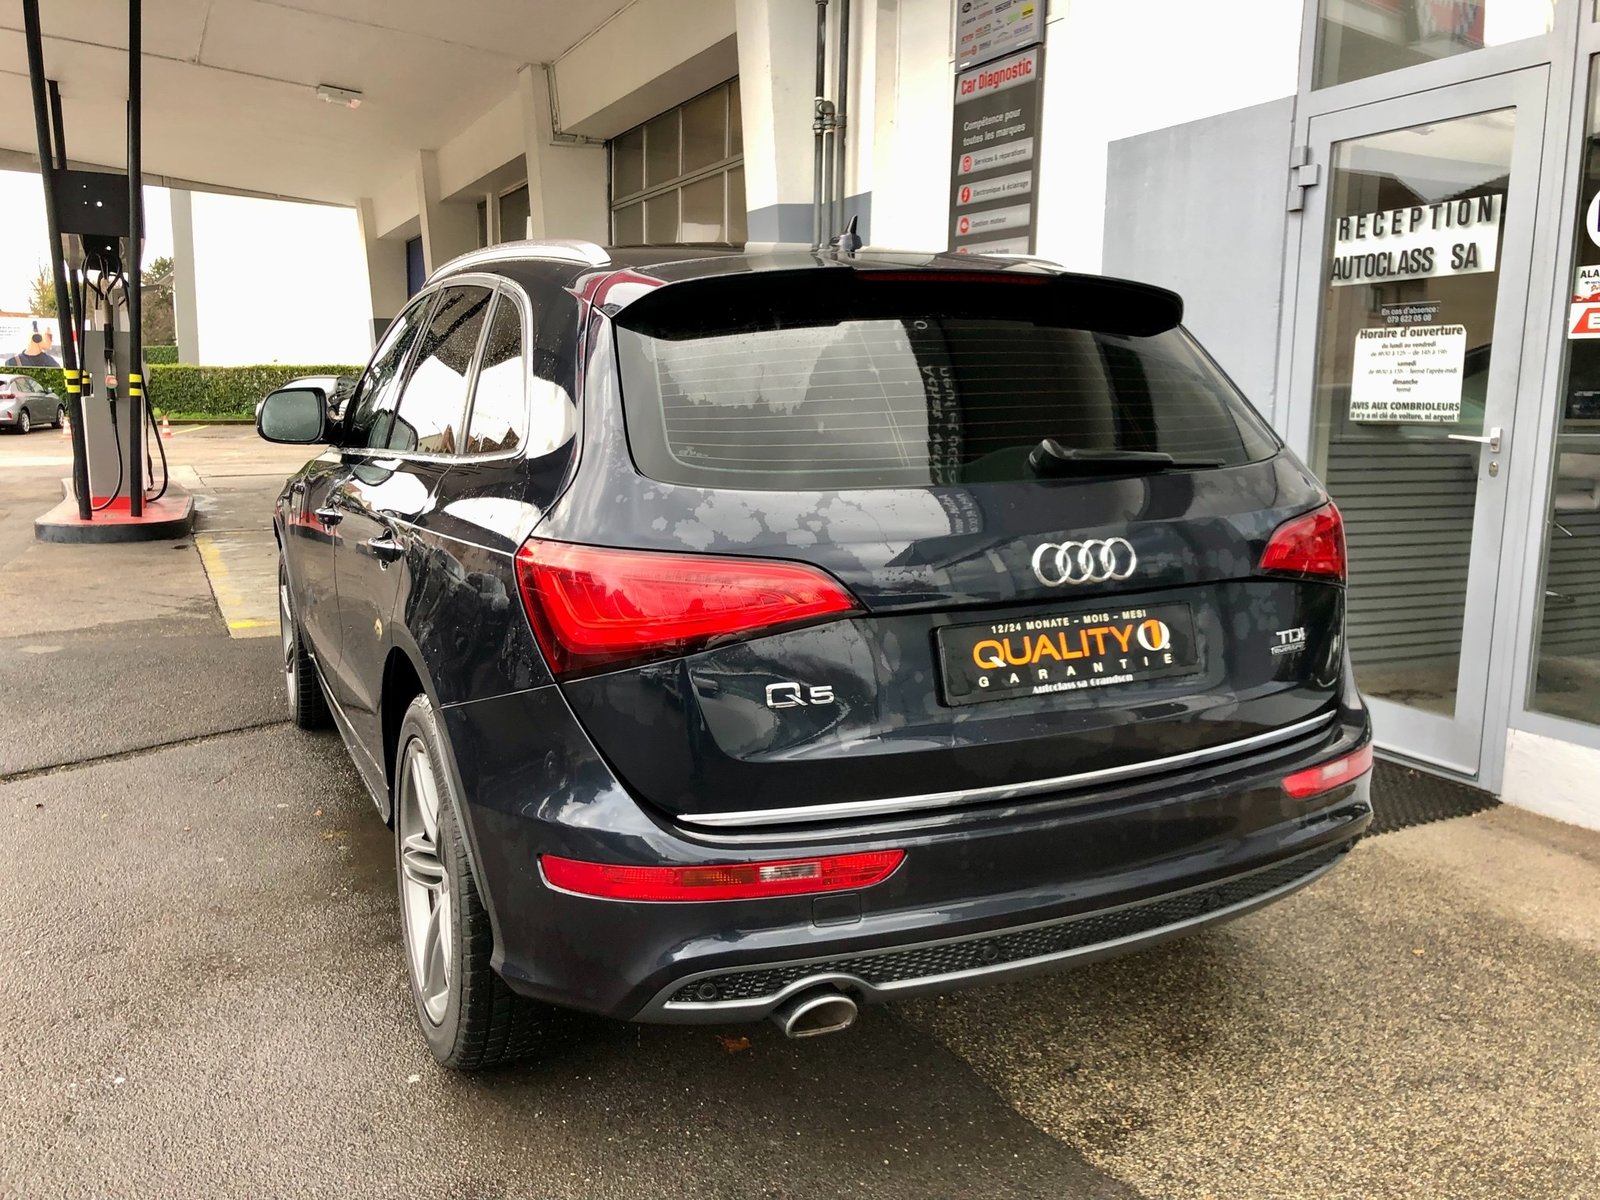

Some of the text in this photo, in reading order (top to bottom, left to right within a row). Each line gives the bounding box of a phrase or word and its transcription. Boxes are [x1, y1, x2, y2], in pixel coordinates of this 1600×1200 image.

[961, 58, 1032, 95] Car Diagnostic
[1005, 109, 1021, 122] pour
[963, 123, 1026, 146] toutes les marques
[1338, 196, 1493, 241] RECEPTION
[1331, 242, 1478, 281] AUTOCLASS SA
[1381, 308, 1390, 316] En
[1391, 308, 1402, 316] cas
[1387, 316, 1399, 324] 079
[1360, 325, 1463, 339] Horaire d'ouverture
[1351, 402, 1370, 410] AVIS
[1371, 402, 1388, 410] AUX
[1433, 413, 1455, 422] argent
[991, 622, 1022, 634] 12/24
[1026, 617, 1069, 630] MONATE
[1083, 612, 1109, 624] MOIS
[1122, 609, 1147, 620] MESI
[1275, 627, 1306, 645] TDI
[973, 624, 1134, 670] QUALITY
[978, 653, 1173, 688] GARANTIE
[1076, 679, 1088, 688] sa
[765, 682, 835, 709] Q5
